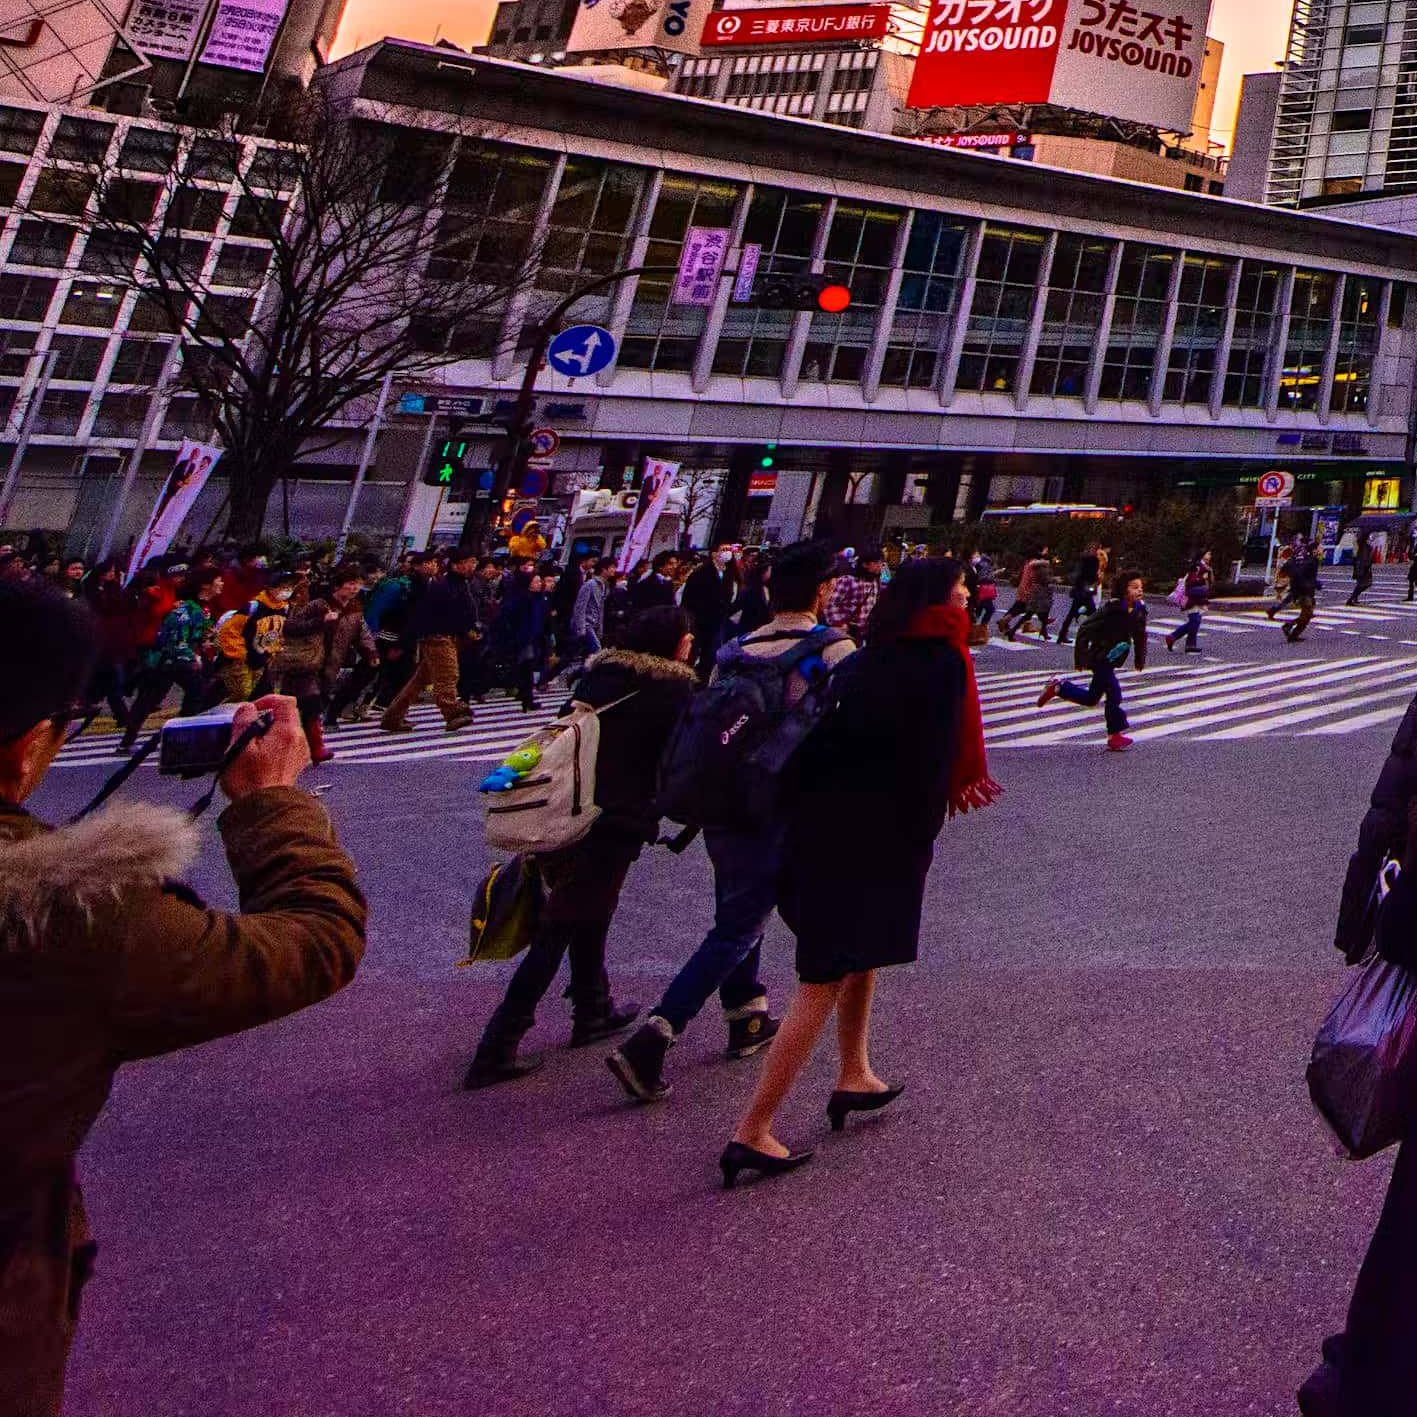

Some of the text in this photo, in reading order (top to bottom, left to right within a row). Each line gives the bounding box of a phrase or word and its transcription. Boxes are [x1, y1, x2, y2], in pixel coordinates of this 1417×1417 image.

[749, 14, 877, 35] 三菱東京UFJ銀行
[925, 25, 1057, 53] JOYSOUND
[1067, 28, 1193, 79] JOYSOUND
[956, 133, 1010, 146] JOYSOUND
